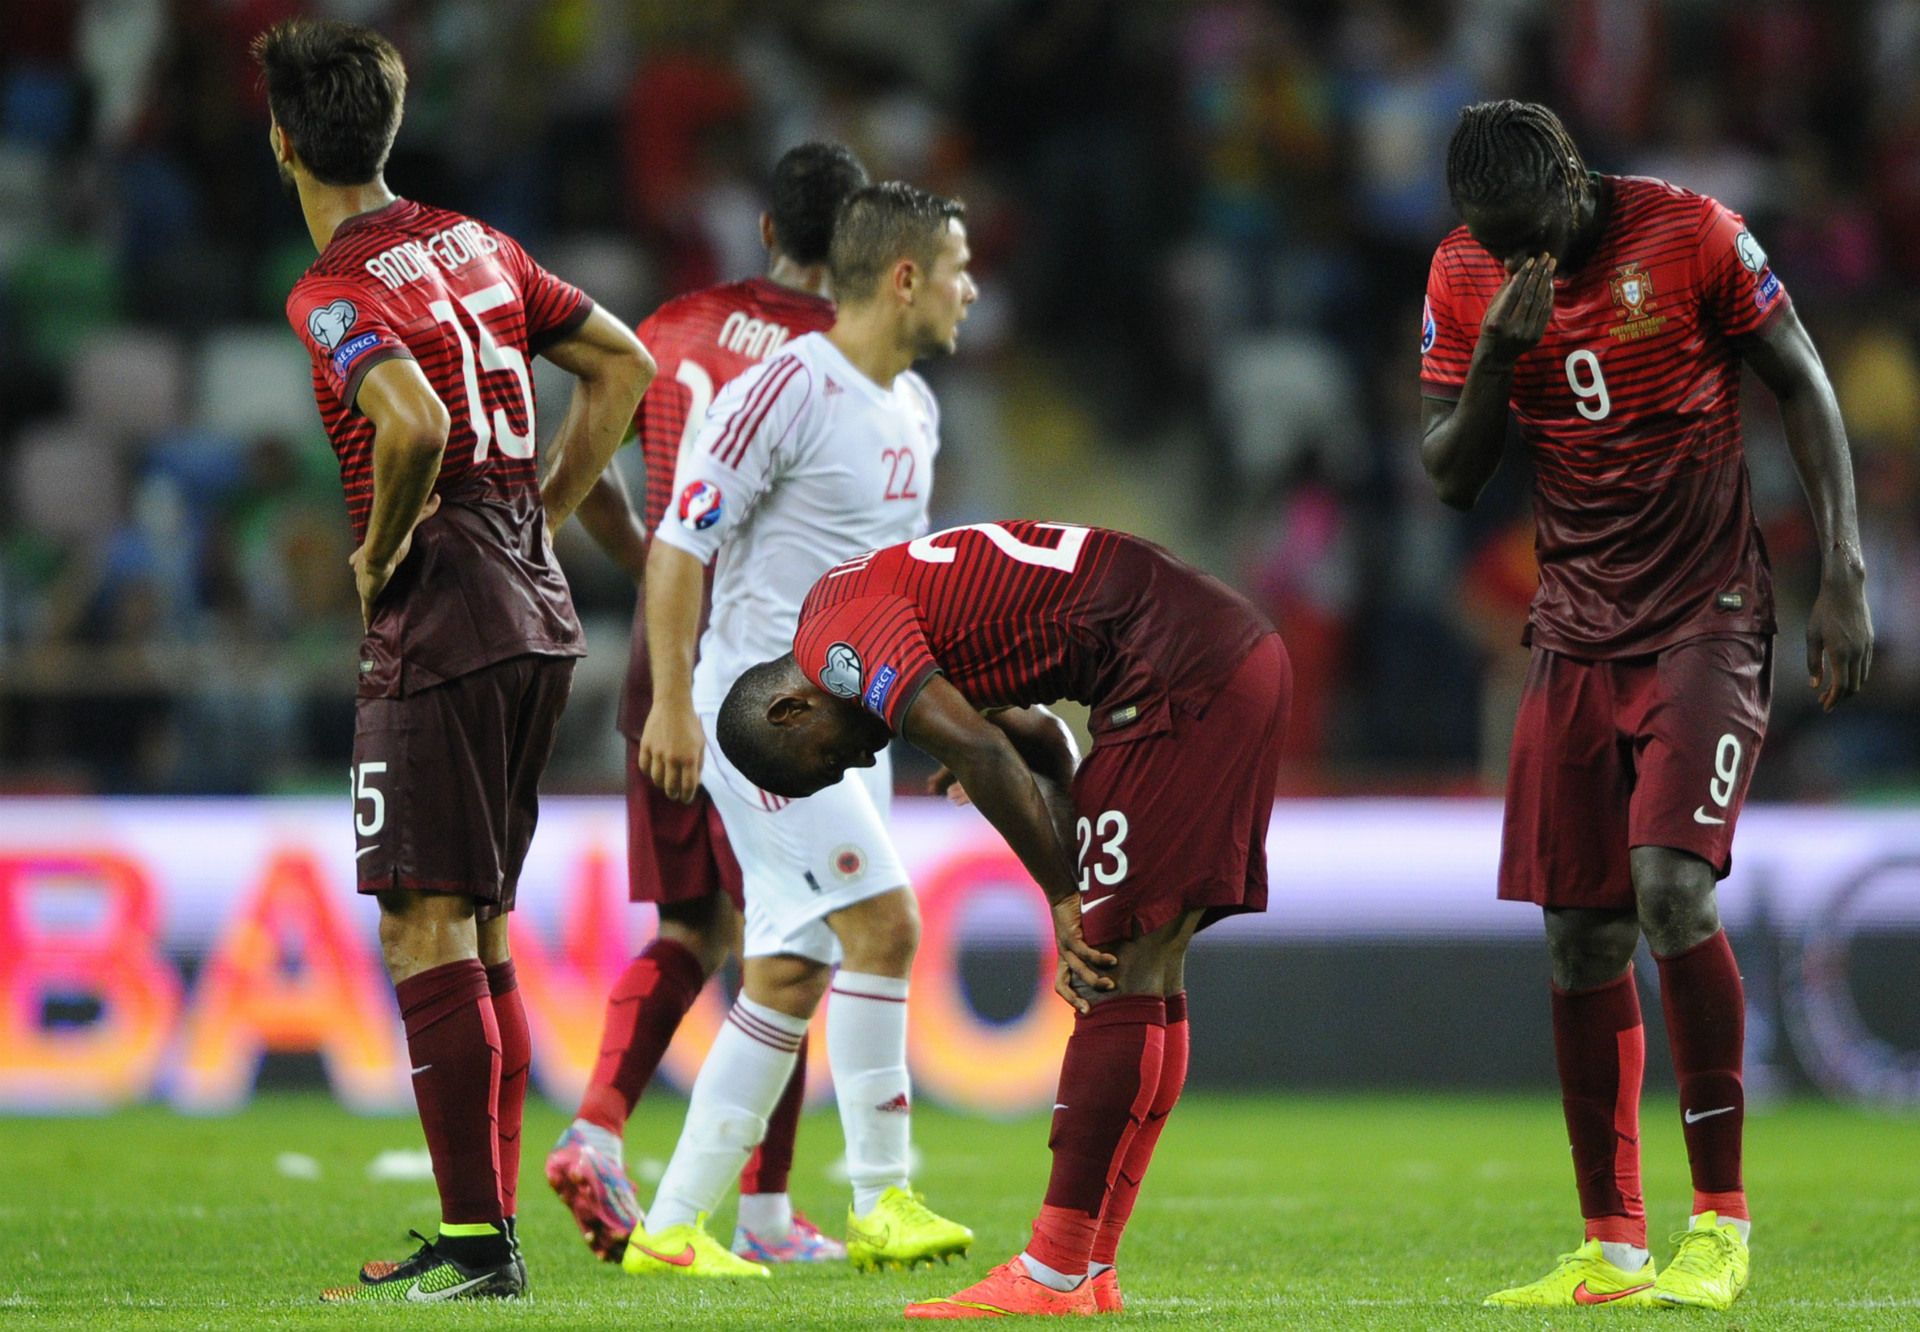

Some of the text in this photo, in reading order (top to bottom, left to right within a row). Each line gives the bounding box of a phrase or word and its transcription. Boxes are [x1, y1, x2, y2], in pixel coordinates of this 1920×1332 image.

[429, 281, 535, 464] 15
[1565, 349, 1611, 421] 9
[881, 448, 918, 500] 22
[869, 667, 892, 709] ESPECT
[1710, 733, 1742, 807] 9
[1077, 810, 1128, 890] 23
